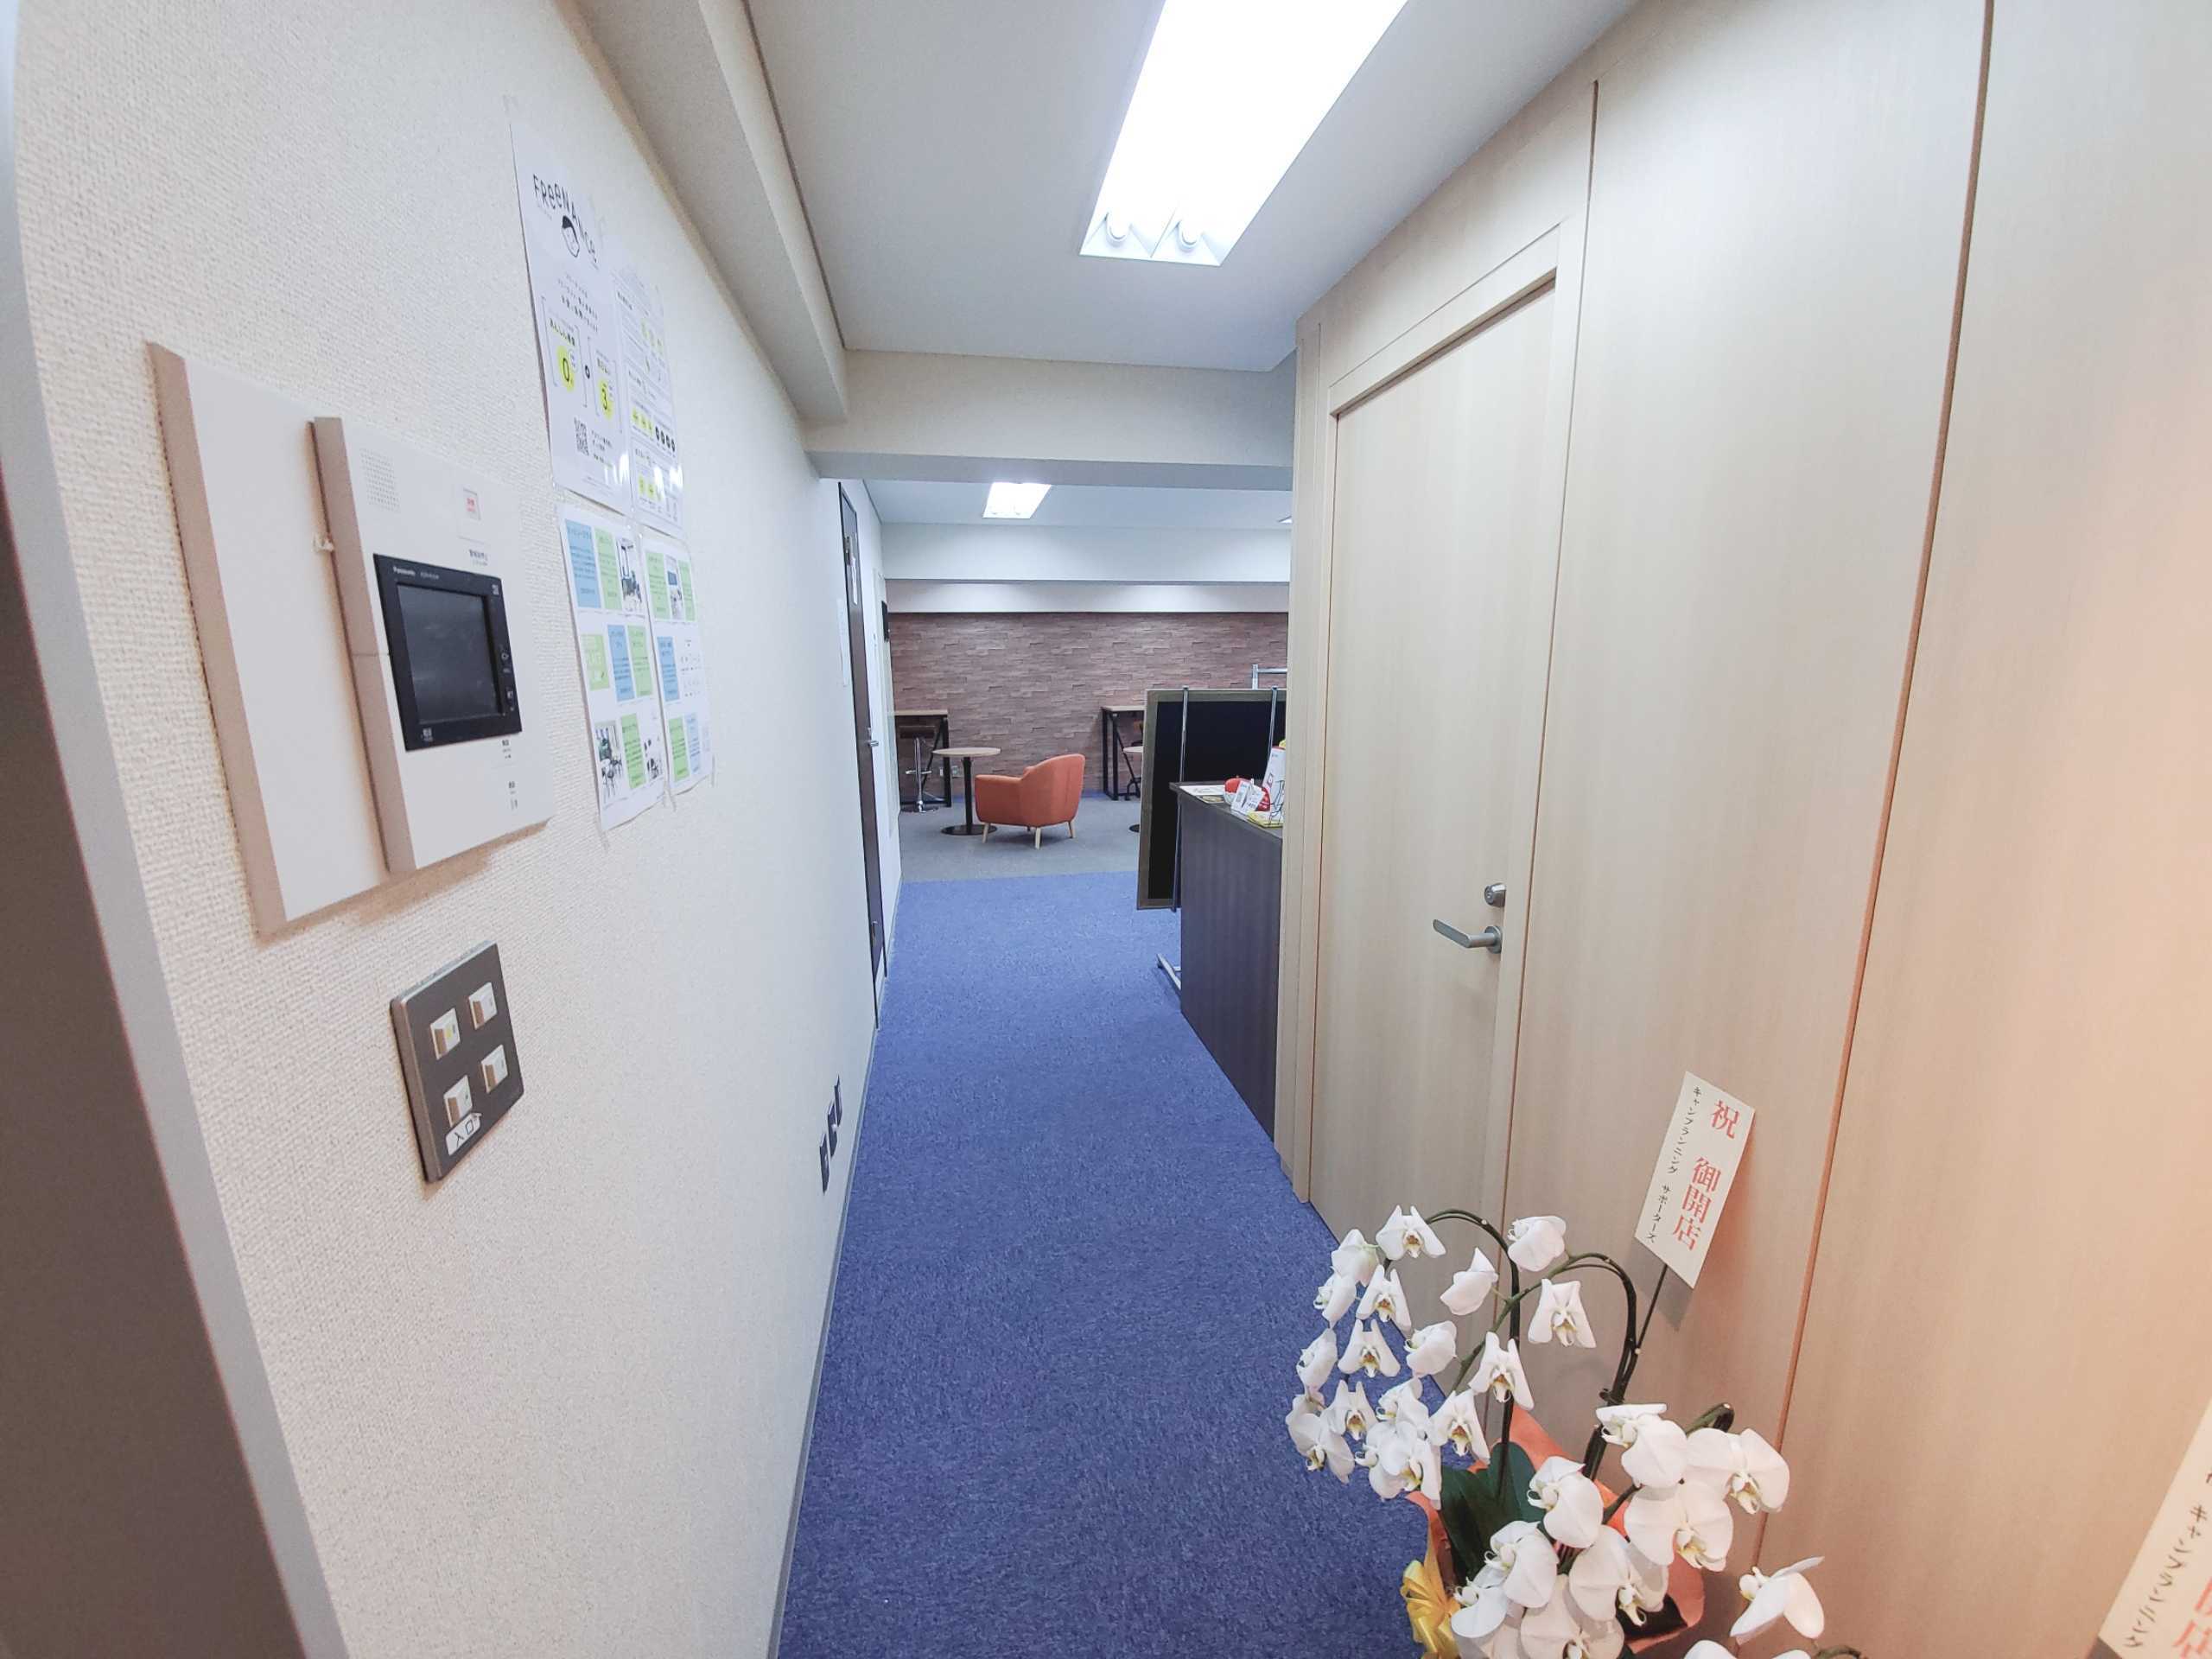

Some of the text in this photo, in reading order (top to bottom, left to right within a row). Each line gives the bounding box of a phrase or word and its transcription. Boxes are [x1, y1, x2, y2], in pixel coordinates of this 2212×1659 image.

[1672, 1099, 1741, 1251] 祝 御開店
